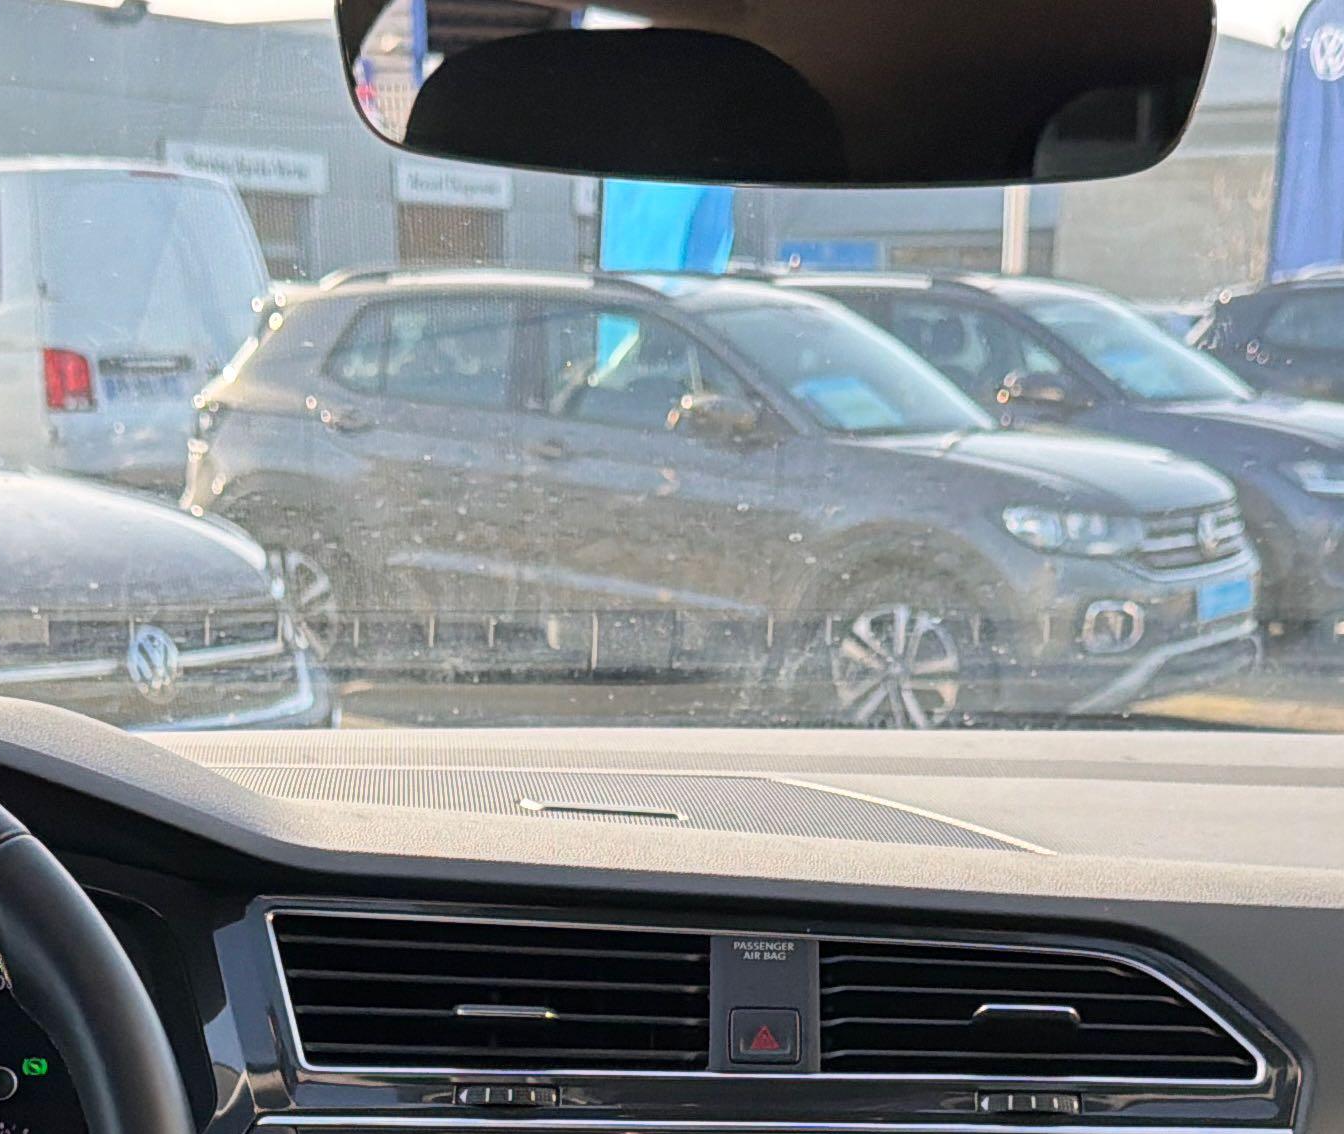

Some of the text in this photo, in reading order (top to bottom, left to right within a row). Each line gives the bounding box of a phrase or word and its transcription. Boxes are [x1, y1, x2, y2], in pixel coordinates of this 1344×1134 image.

[733, 941, 795, 951] PASSENGER
[742, 951, 787, 961] AIR BAG
